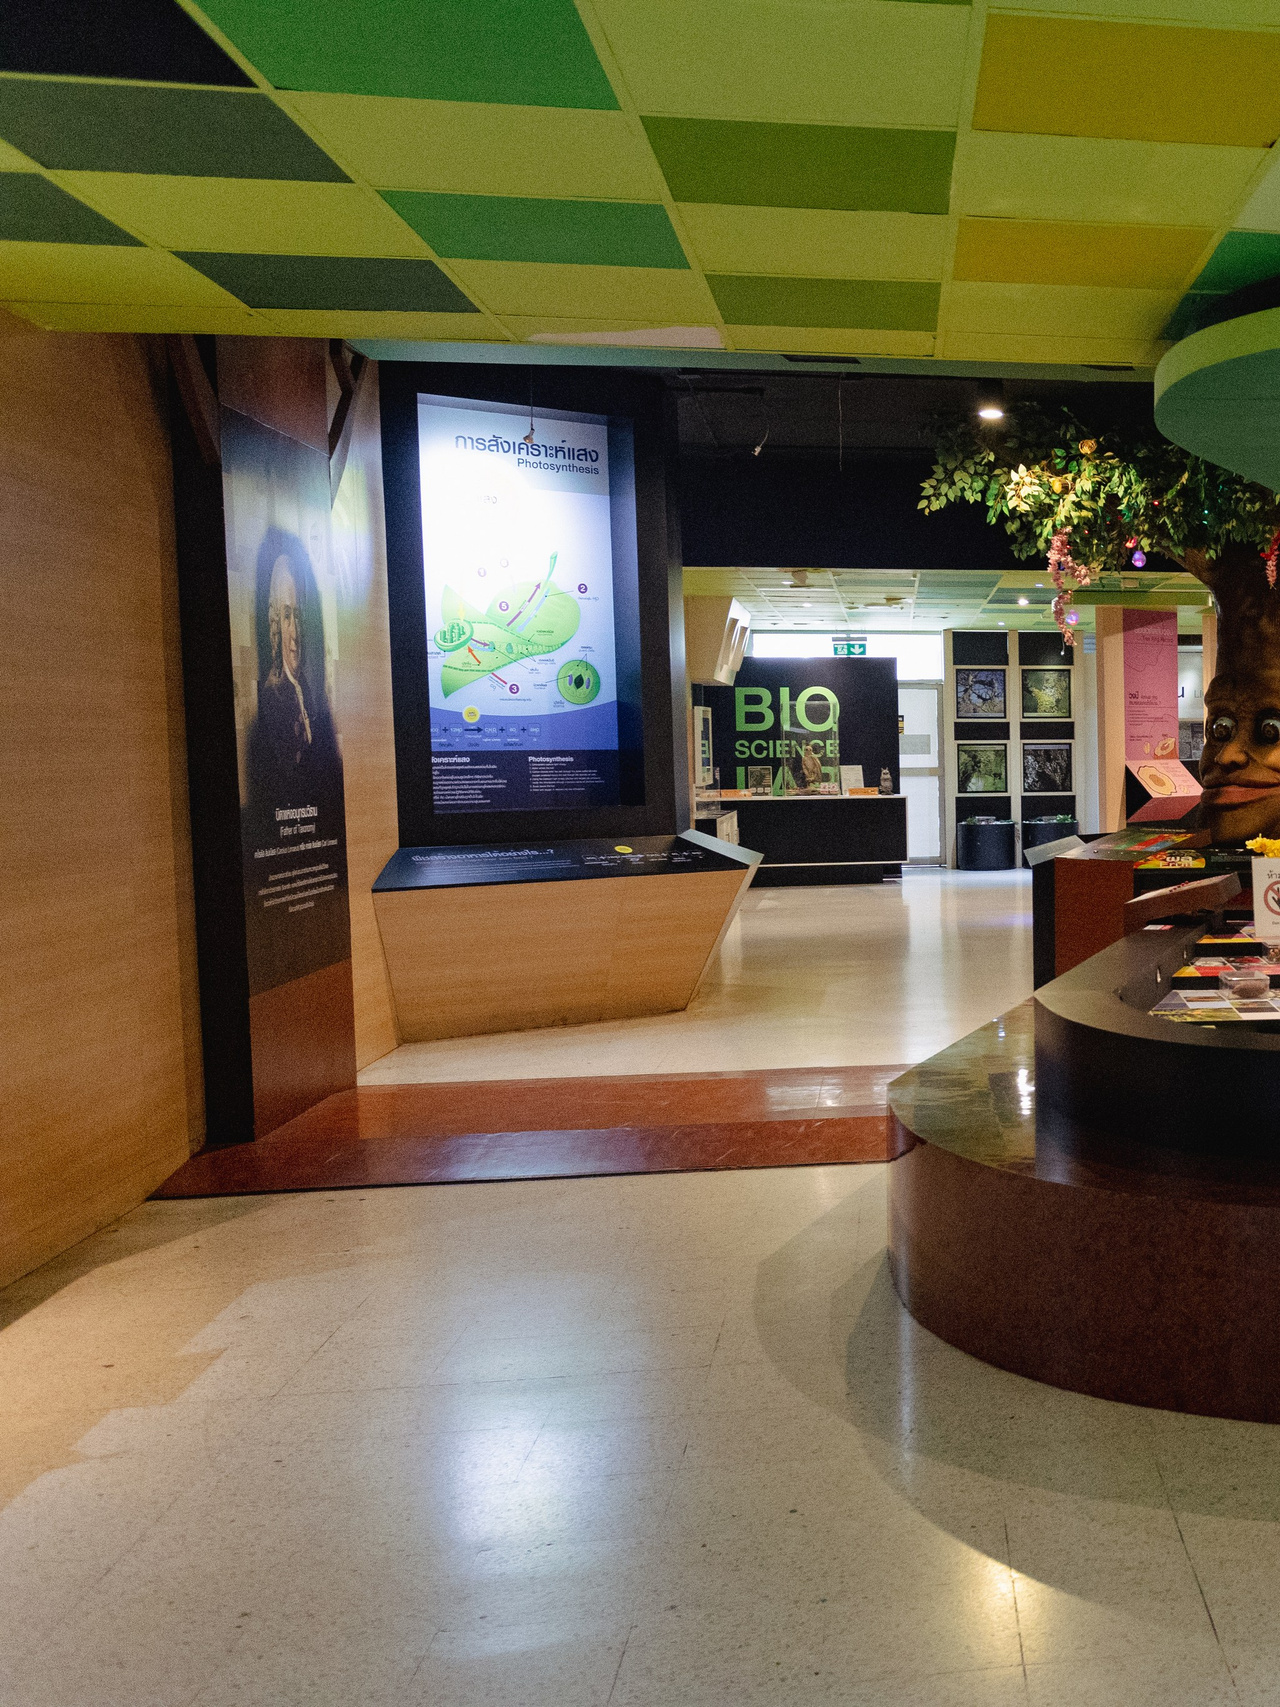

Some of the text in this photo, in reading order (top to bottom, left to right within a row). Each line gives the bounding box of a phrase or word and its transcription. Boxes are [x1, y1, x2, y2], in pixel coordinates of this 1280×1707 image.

[455, 434, 599, 463] การสังเคราะห์แสง
[517, 458, 600, 475] Photosynthesis
[735, 686, 840, 732] BIO
[735, 739, 840, 759] SCIENCE
